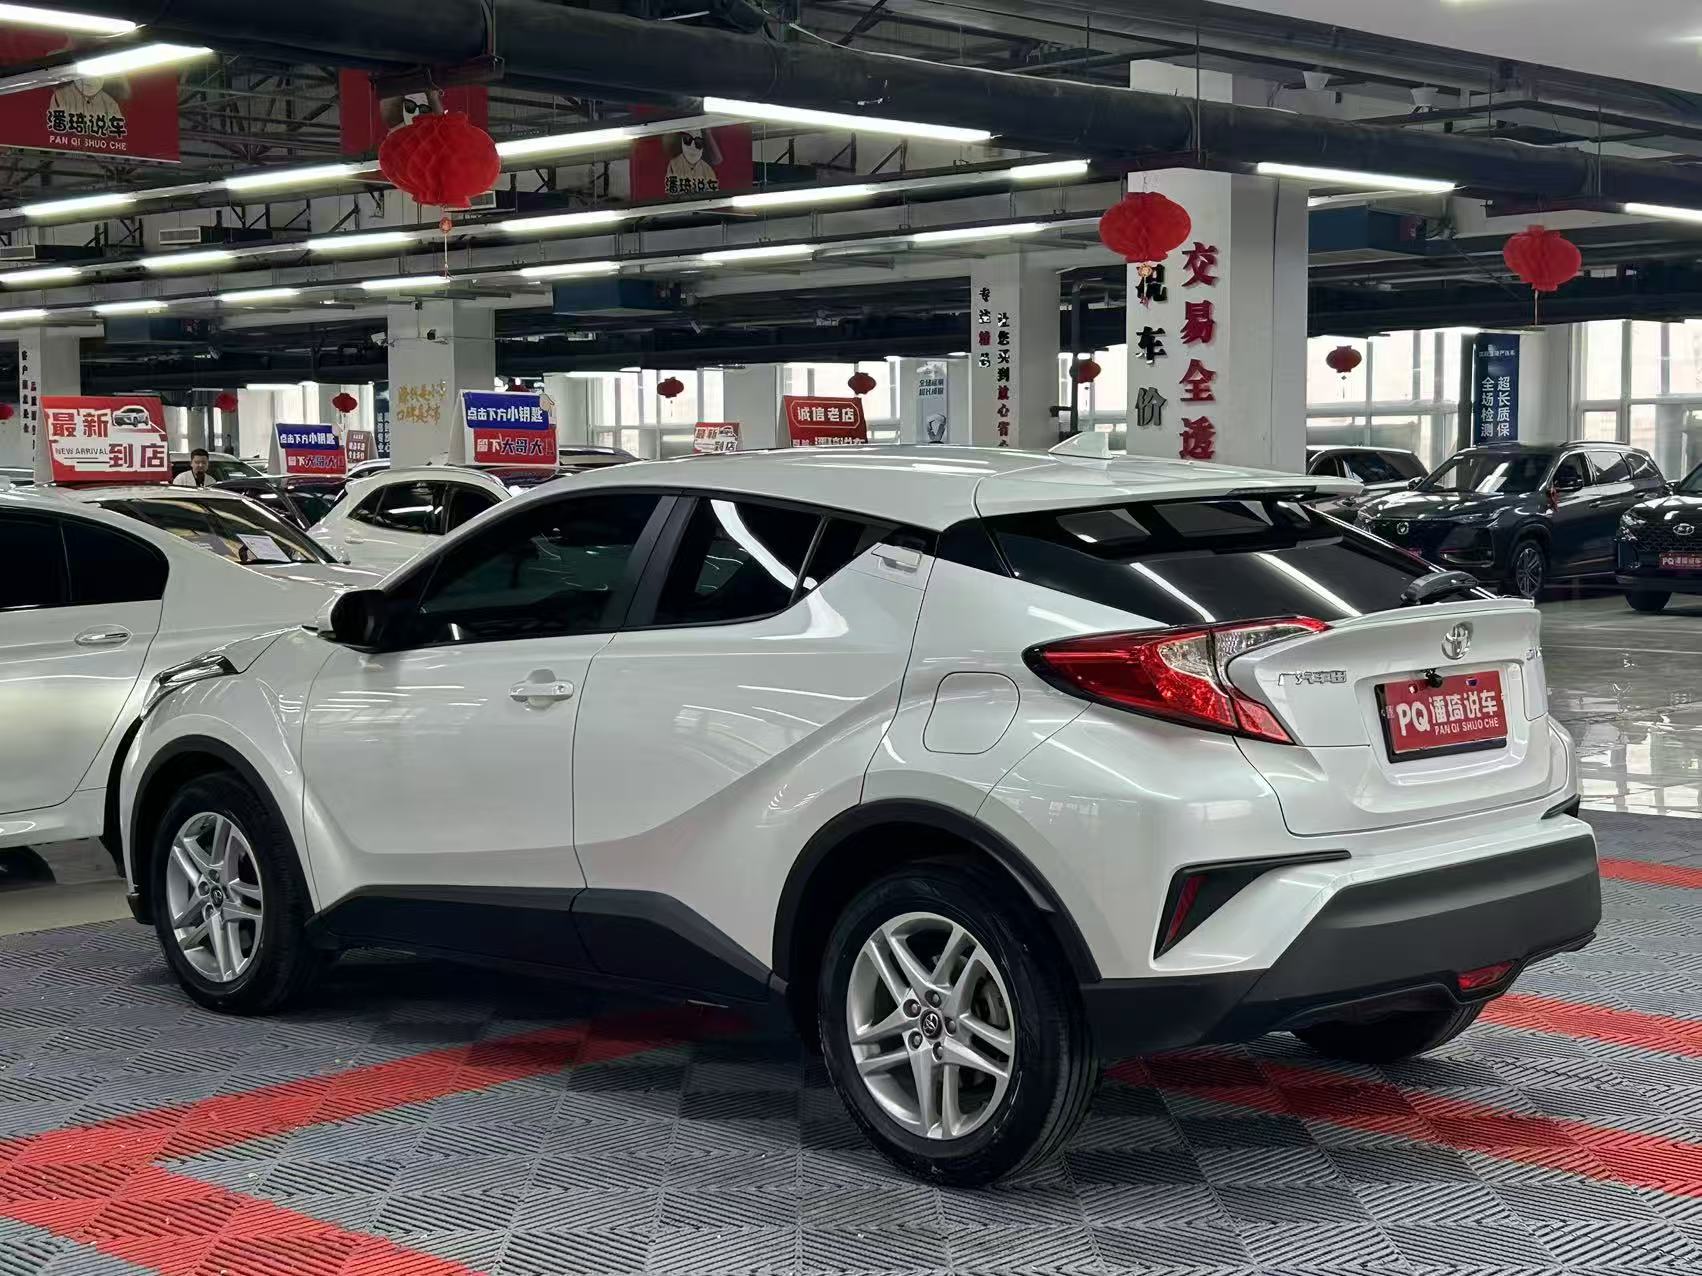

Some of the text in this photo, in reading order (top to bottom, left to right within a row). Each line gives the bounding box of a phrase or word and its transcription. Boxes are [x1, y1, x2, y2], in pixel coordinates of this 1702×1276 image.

[48, 109, 127, 138] 潘琦说车
[50, 135, 127, 151] PAN QI SHUO CHE
[1178, 241, 1219, 460] 交易全透
[467, 406, 543, 423] 点击下方小钥匙
[797, 406, 855, 422] 诚信老店
[1480, 377, 1495, 437] 全场检测
[1497, 376, 1510, 437] 超长质保
[50, 411, 109, 438] 最新
[55, 446, 108, 456] NEW ARRIVAL
[108, 442, 165, 469] 到店
[476, 438, 544, 456] 留下大哥大
[1396, 689, 1498, 737] PQ 潘琦说车
[1434, 717, 1499, 735] PAN QI SHUO CHE
